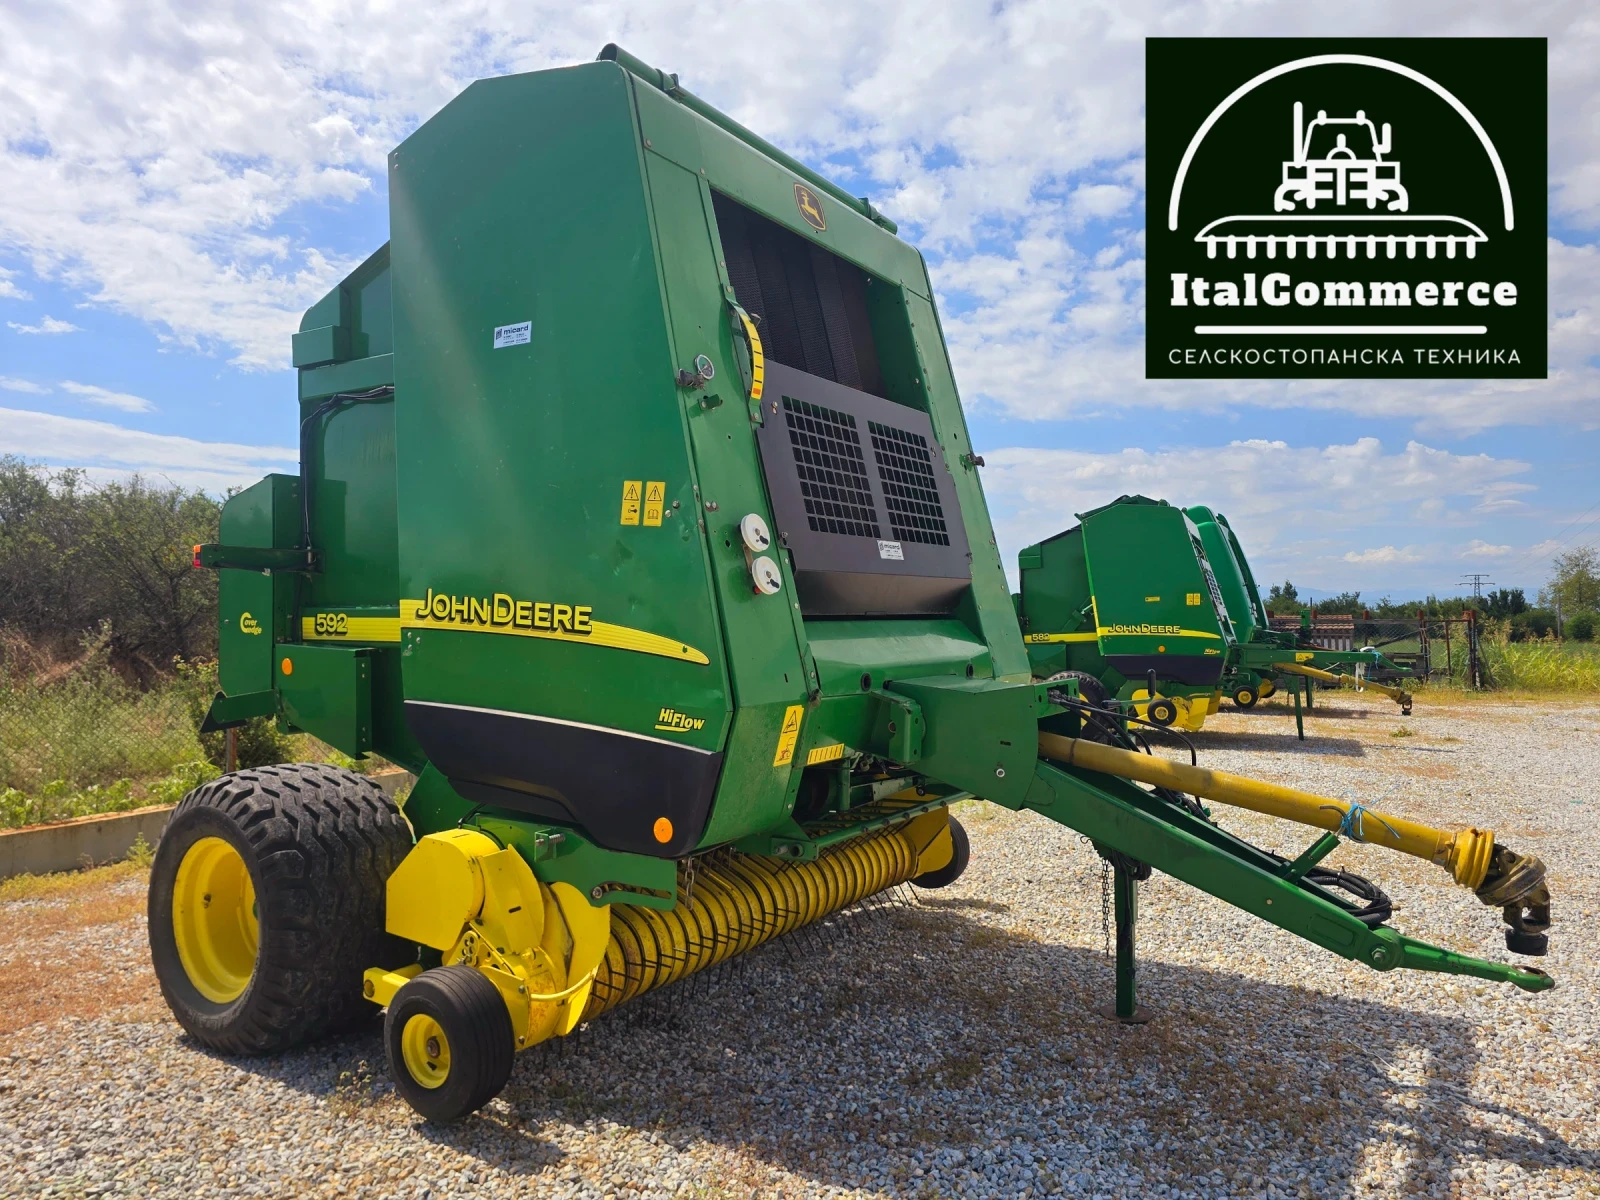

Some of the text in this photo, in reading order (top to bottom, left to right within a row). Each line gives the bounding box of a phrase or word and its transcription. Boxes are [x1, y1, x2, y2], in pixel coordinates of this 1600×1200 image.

[503, 324, 529, 336] micard
[416, 588, 592, 635] JOHN DEERE
[316, 613, 348, 635] 592
[1141, 623, 1181, 633] DEERE
[658, 707, 705, 730] HiFlow
